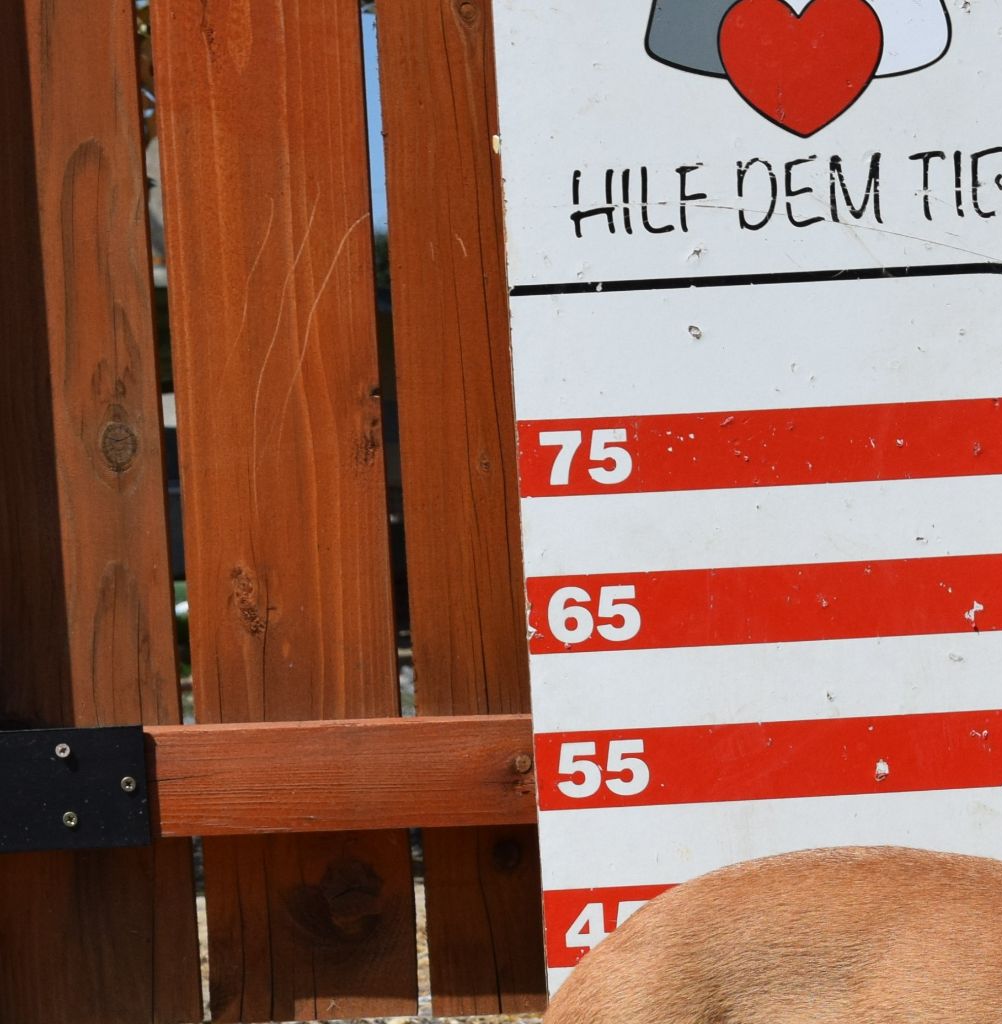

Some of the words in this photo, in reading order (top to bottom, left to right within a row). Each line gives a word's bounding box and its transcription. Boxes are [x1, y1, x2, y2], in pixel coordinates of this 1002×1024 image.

[570, 162, 707, 238] HILF
[736, 151, 882, 231] DEM
[538, 428, 634, 487] 75
[547, 585, 642, 644] 65
[556, 739, 650, 799] 55
[565, 901, 649, 950] 4
